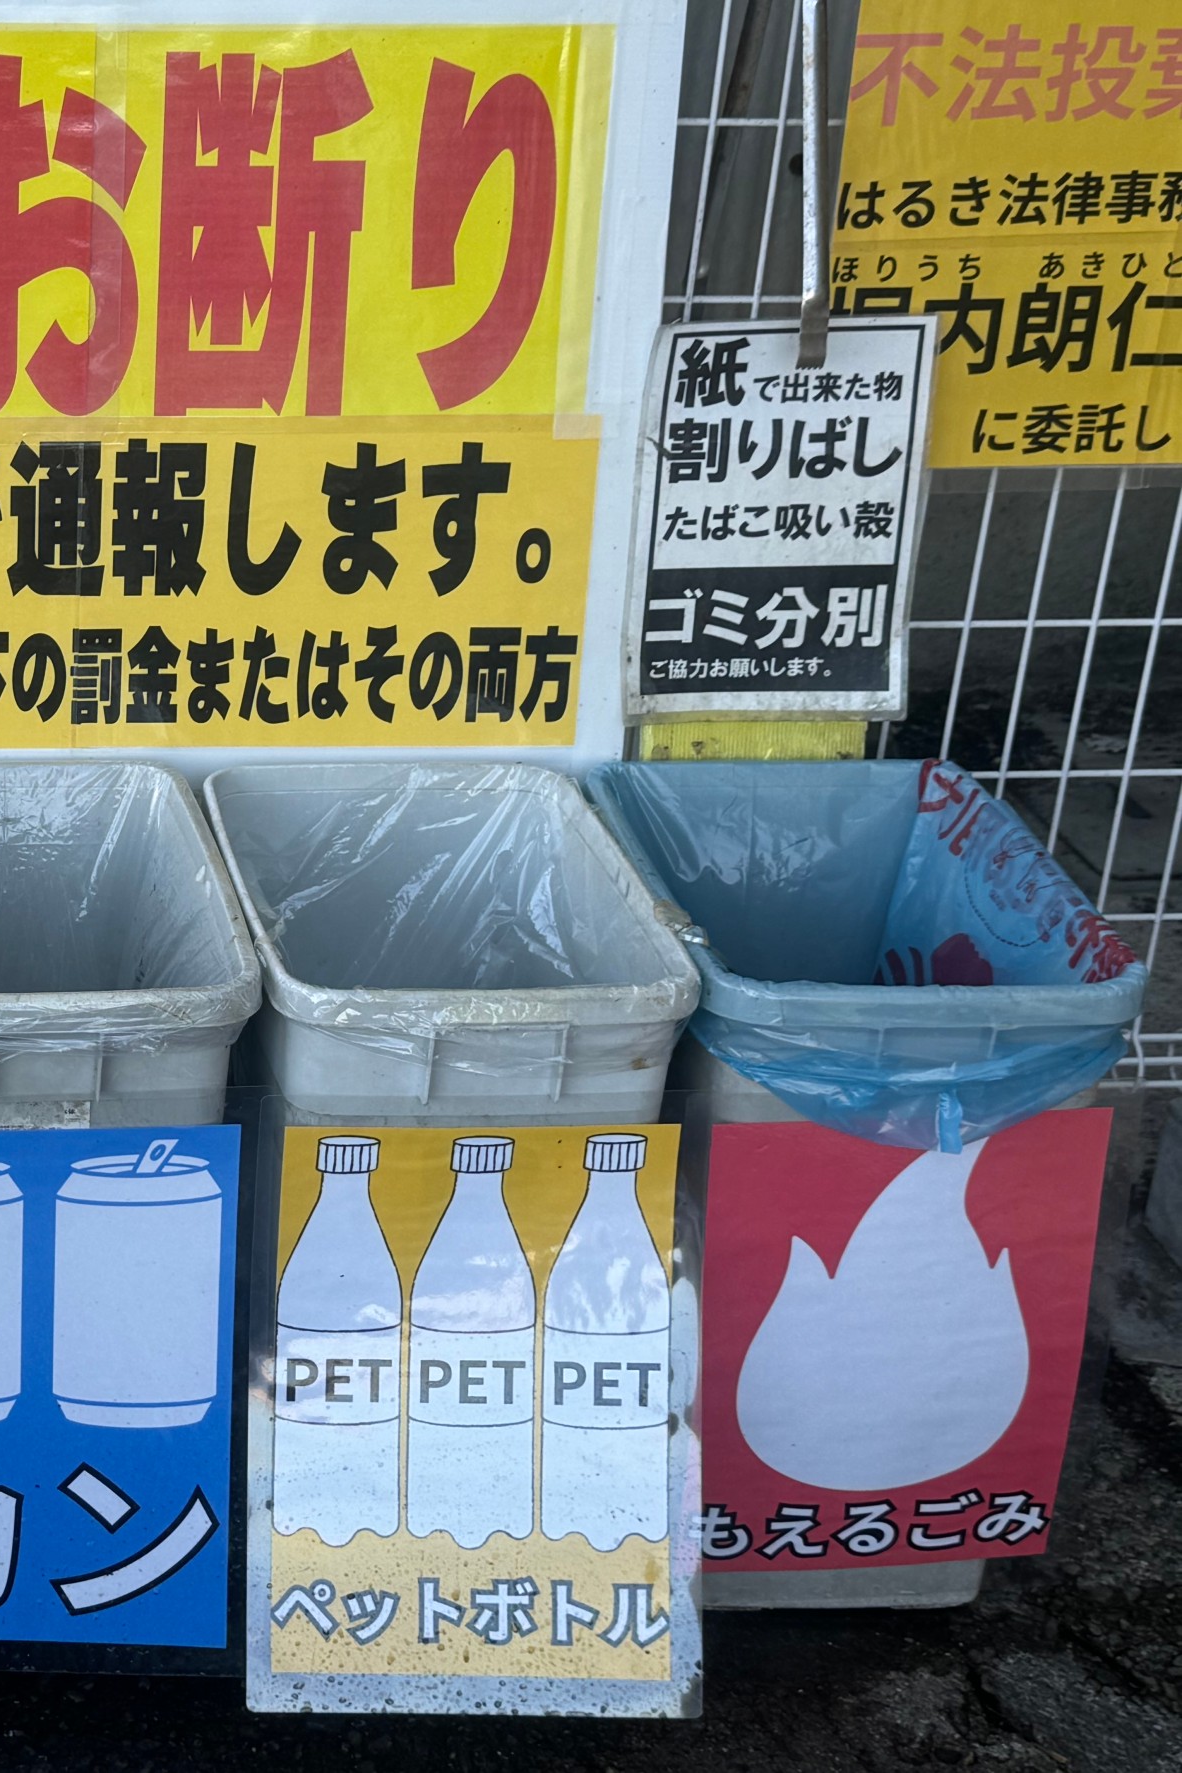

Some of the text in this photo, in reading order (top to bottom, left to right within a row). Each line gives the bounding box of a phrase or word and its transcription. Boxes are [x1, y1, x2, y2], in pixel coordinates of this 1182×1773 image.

[832, 254, 981, 283] ほりうち
[674, 337, 902, 408] 紙で出来た物
[667, 415, 903, 484] 割りばし
[972, 403, 1171, 455] に委託し
[662, 500, 895, 541] たばこ吸い殻
[645, 584, 889, 650] ゴミ分別
[649, 656, 833, 679] ご協力お願いします。
[285, 1357, 393, 1403] PET
[419, 1359, 526, 1405] PET
[553, 1361, 661, 1408] PET
[689, 1487, 1050, 1561] もえるごみ
[270, 1576, 670, 1650] ペットボトル
